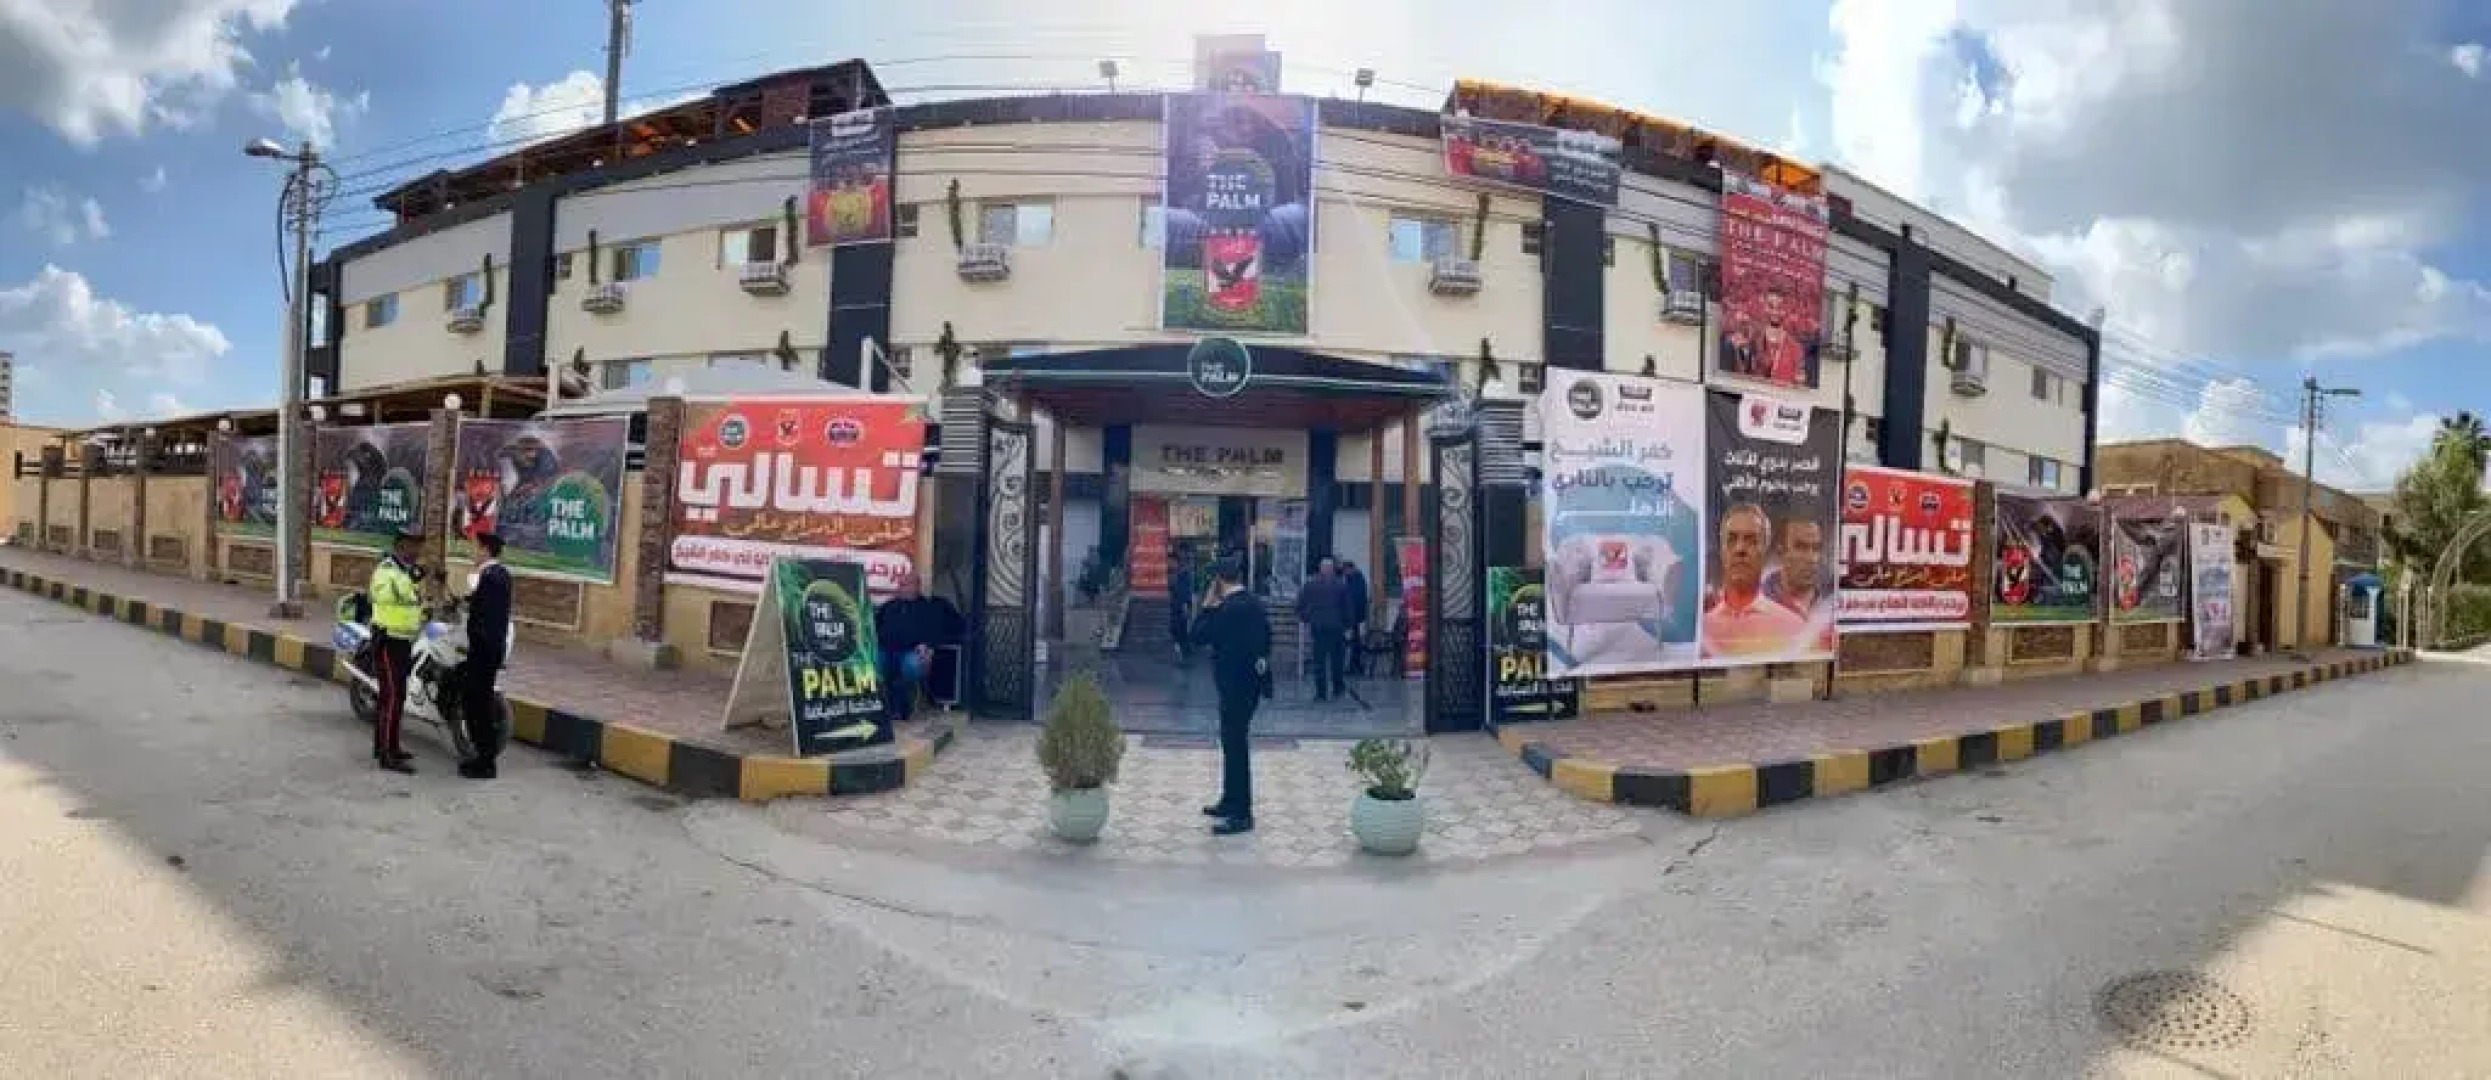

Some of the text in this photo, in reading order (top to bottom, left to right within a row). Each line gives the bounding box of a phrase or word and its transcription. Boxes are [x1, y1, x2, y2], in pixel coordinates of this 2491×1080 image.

[1206, 173, 1247, 190] THE
[1206, 193, 1261, 210] PALM
[1202, 371, 1240, 383] PALM
[1163, 446, 1284, 465] THE PALM
[678, 452, 919, 522] تسالي
[551, 500, 585, 519] THE
[548, 518, 595, 541] PALM
[1500, 655, 1547, 682] PAL
[802, 664, 877, 701] PALM
